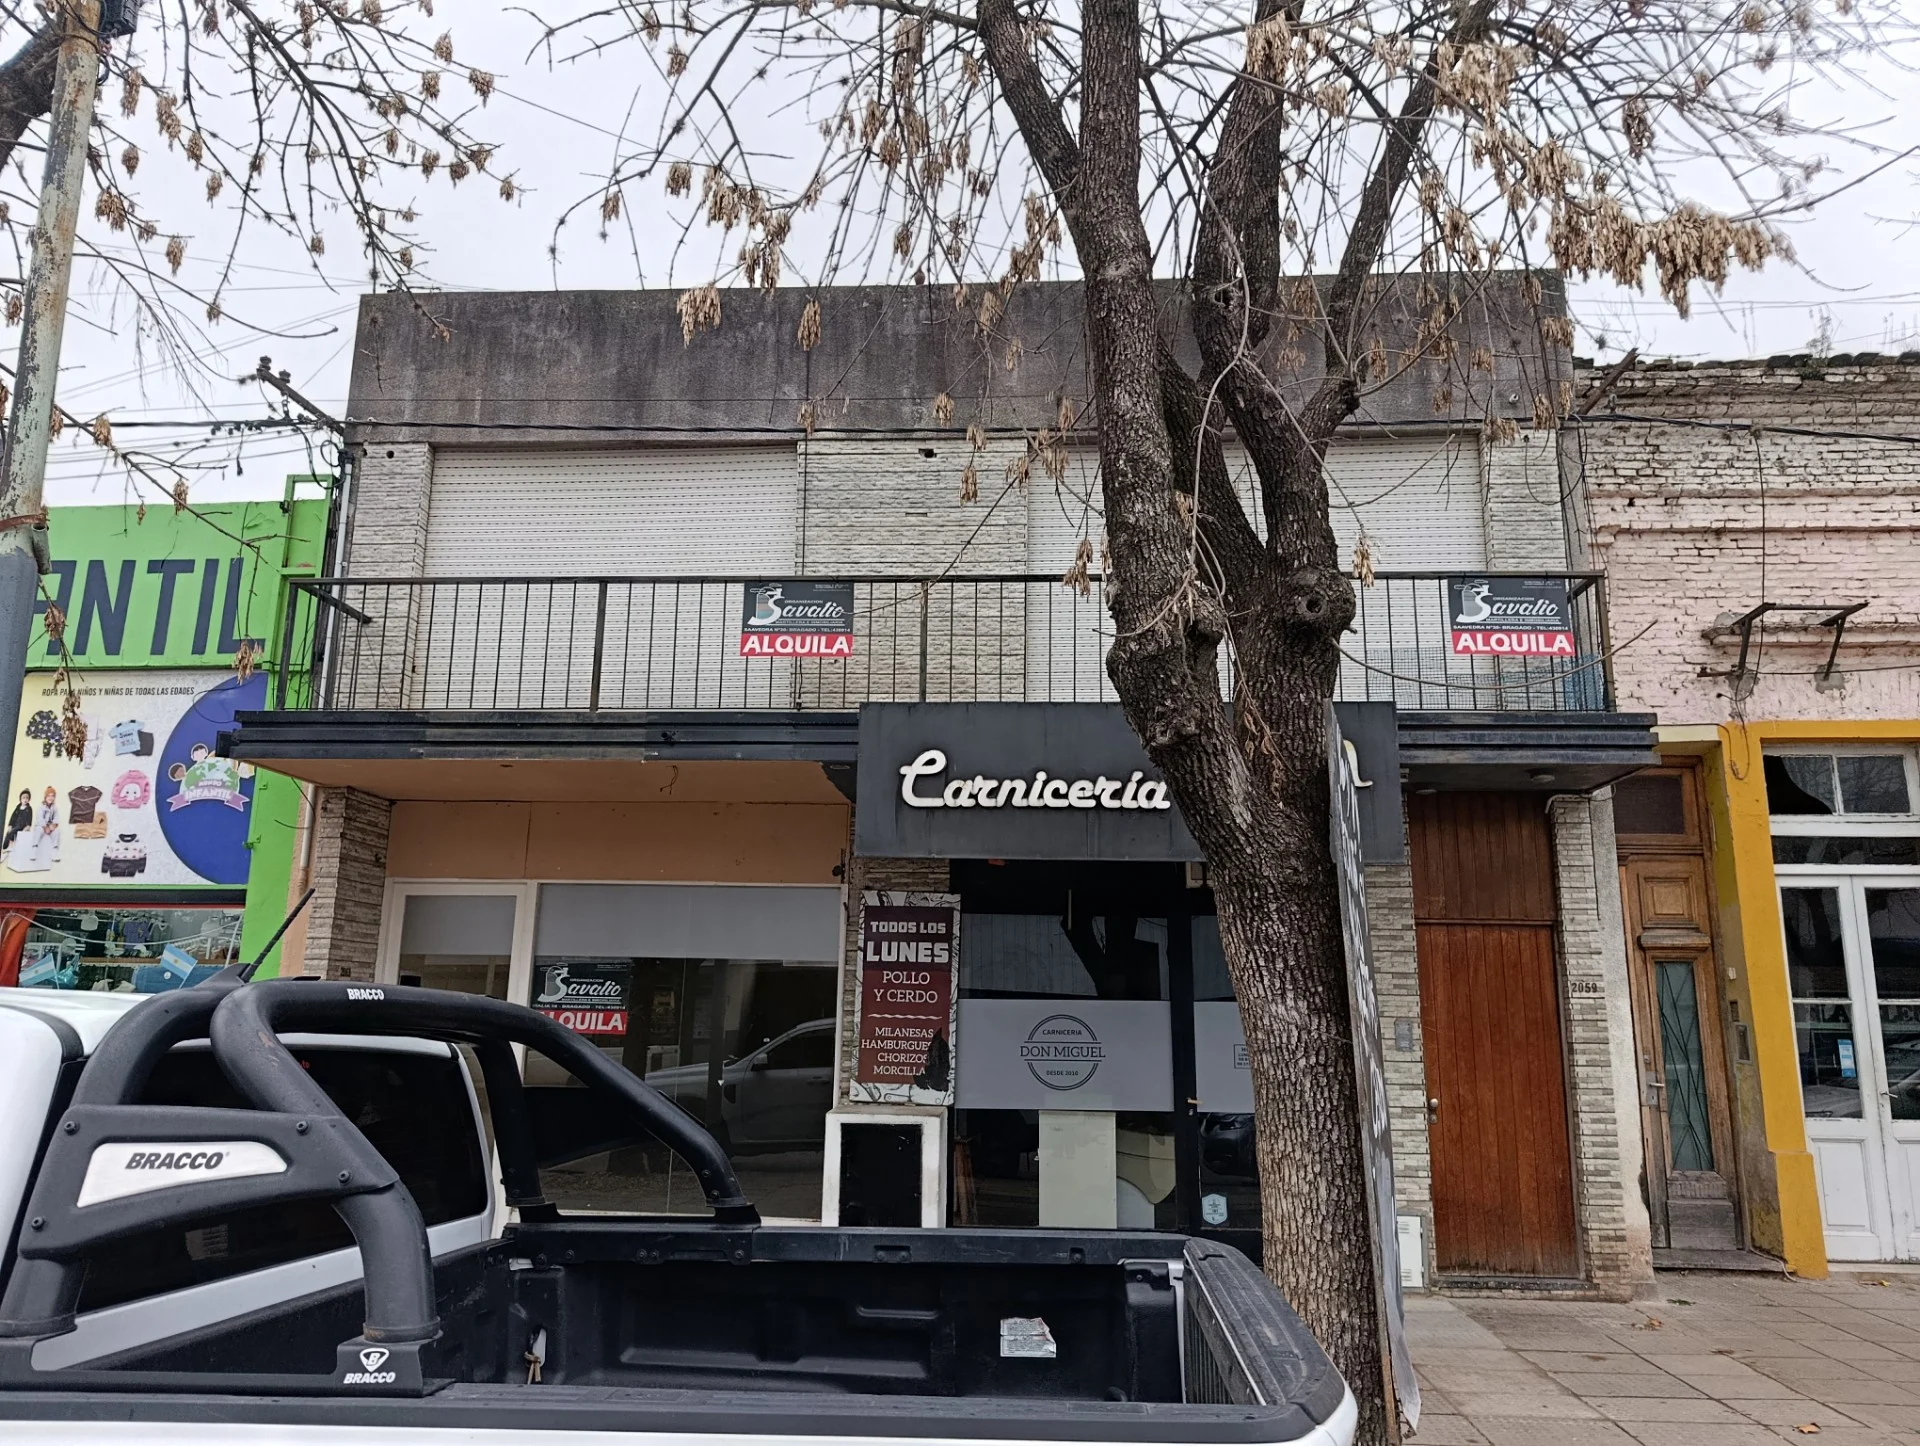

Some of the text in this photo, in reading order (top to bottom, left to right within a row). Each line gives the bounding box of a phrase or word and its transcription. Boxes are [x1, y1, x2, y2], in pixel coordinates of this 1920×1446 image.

[747, 591, 845, 626] Savalio
[1455, 588, 1559, 623] Savalio
[742, 635, 850, 654] ALQUILA
[1456, 633, 1573, 653] ALQUILA
[42, 688, 58, 696] ROPA
[77, 686, 97, 696] NIÑOS
[98, 688, 104, 696] Y
[103, 686, 123, 696] NIÑAS
[125, 687, 134, 696] DE
[135, 687, 155, 696] TODAS
[156, 687, 169, 696] LAS
[170, 687, 195, 696] EDADES
[184, 787, 232, 800] INFANTIL
[870, 921, 946, 934] TODOS LOS
[866, 941, 949, 964] LUNES
[882, 971, 930, 985] POLLO
[537, 970, 622, 1003] Savalio
[1571, 982, 1598, 993] 2059
[346, 988, 385, 1001] BRACCO
[874, 989, 938, 1004] Y CERDO
[875, 1027, 934, 1038] MILANESAS
[1020, 1045, 1106, 1058] DON MIGUEL
[125, 1152, 224, 1170] BRACCO
[366, 1352, 381, 1366] B
[343, 1372, 396, 1384] BRACCO
